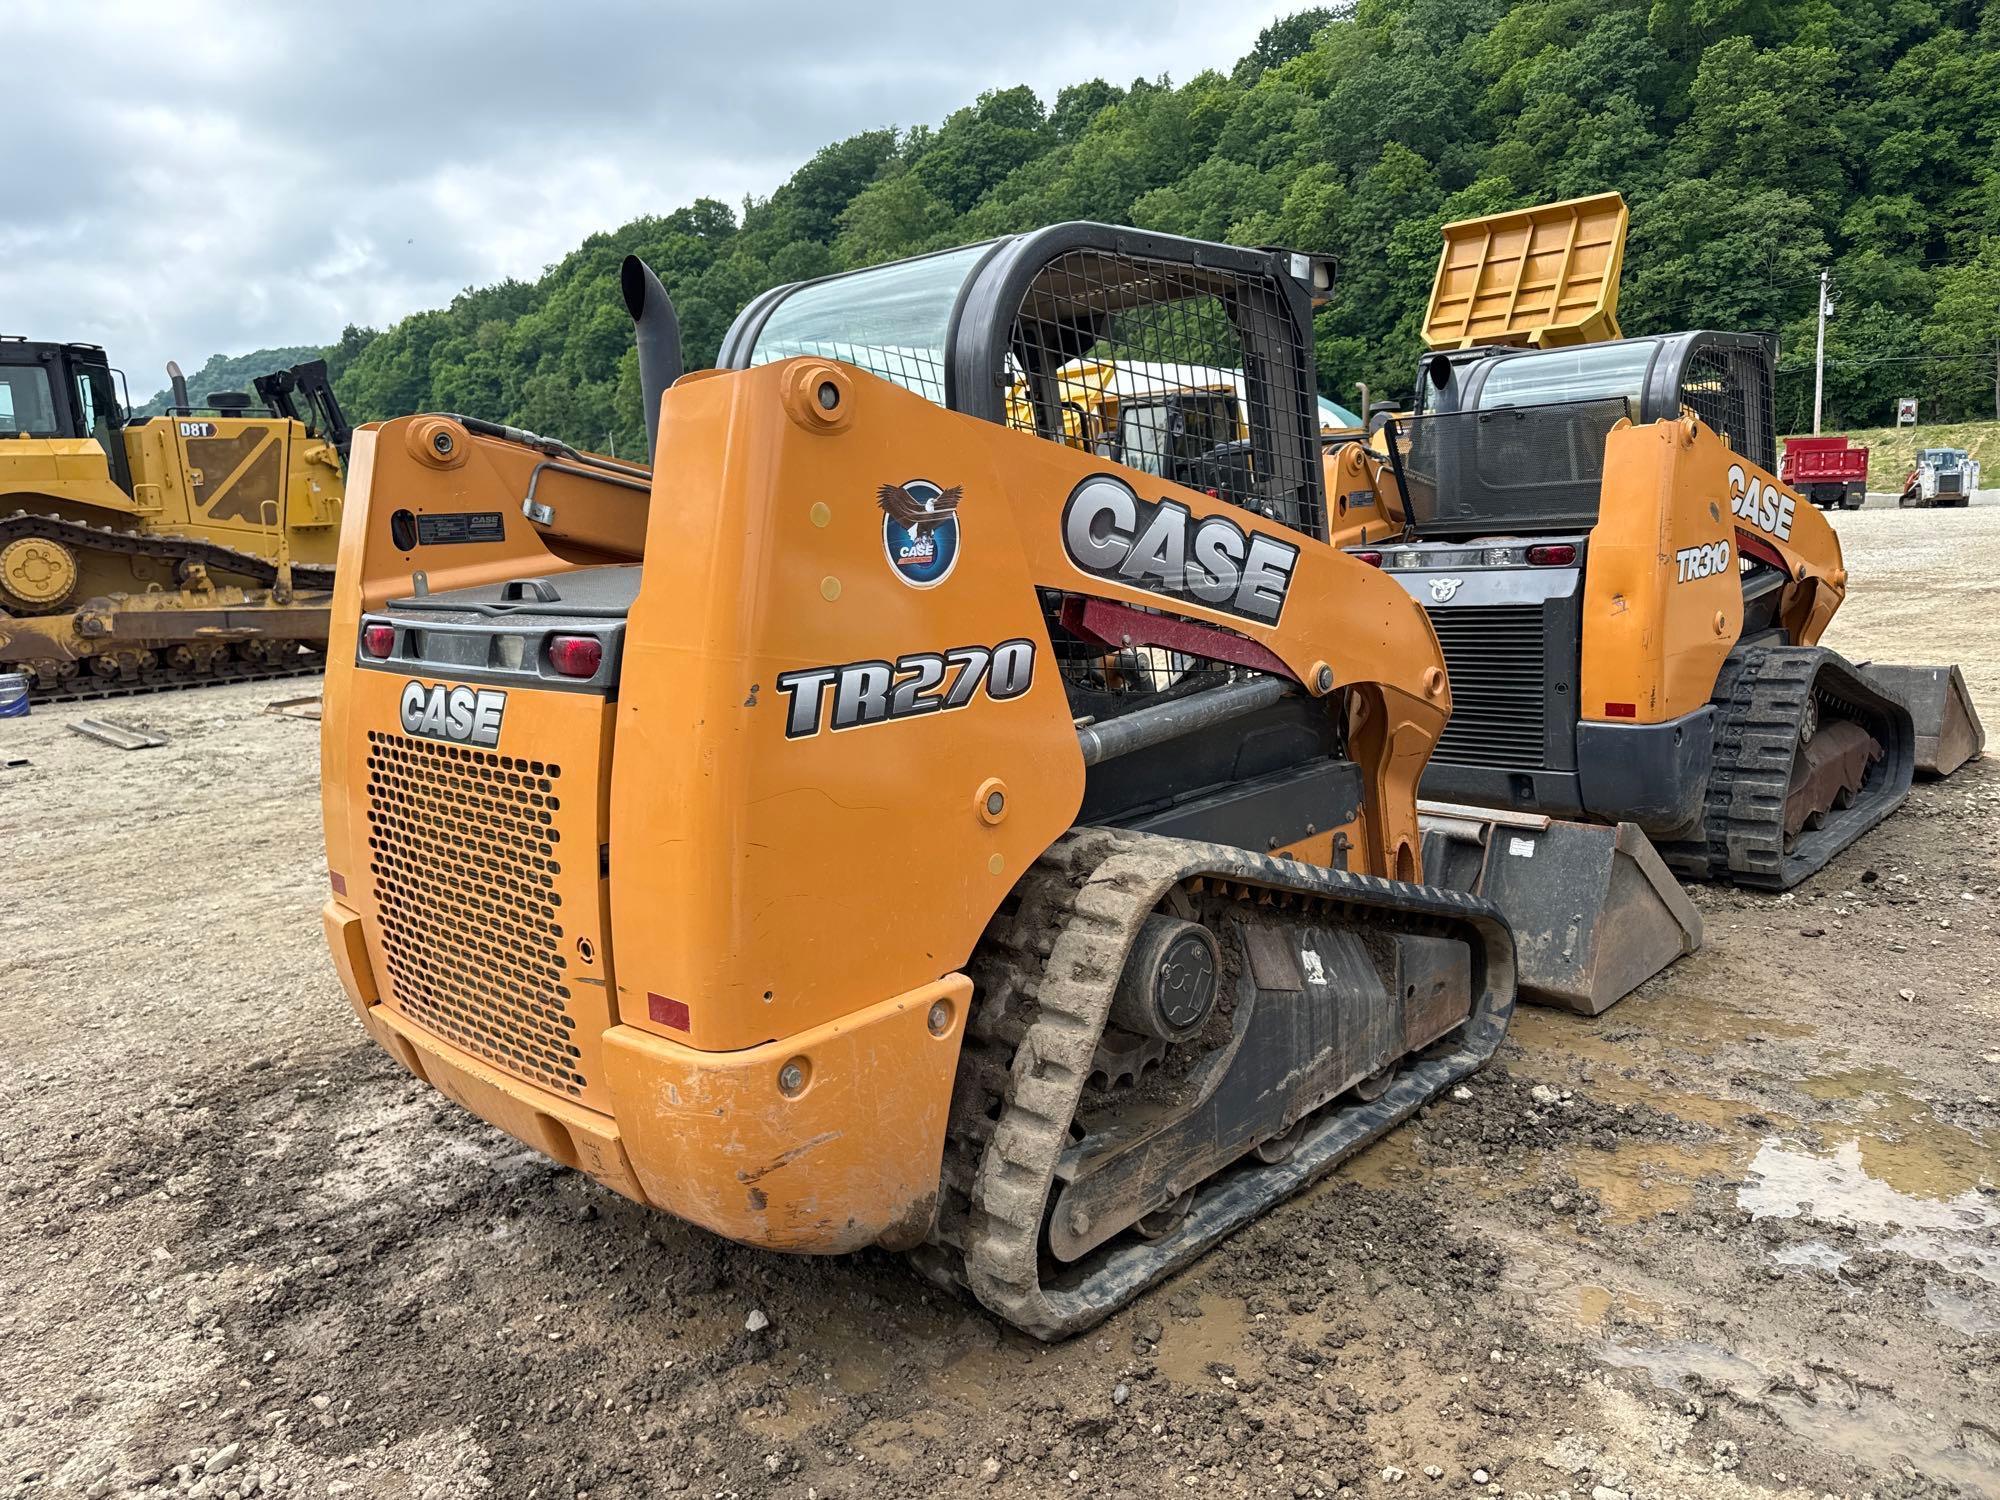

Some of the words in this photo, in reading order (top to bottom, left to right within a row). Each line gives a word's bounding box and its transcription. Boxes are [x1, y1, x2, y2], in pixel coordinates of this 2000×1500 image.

[180, 422, 209, 437] D8T
[471, 515, 499, 525] CASE
[1728, 464, 1796, 542] CASE
[899, 545, 934, 558] CASE
[1065, 479, 1297, 621] CASE
[1677, 540, 1730, 584] TR310
[401, 680, 507, 746] CASE
[779, 640, 1036, 737] TR270
